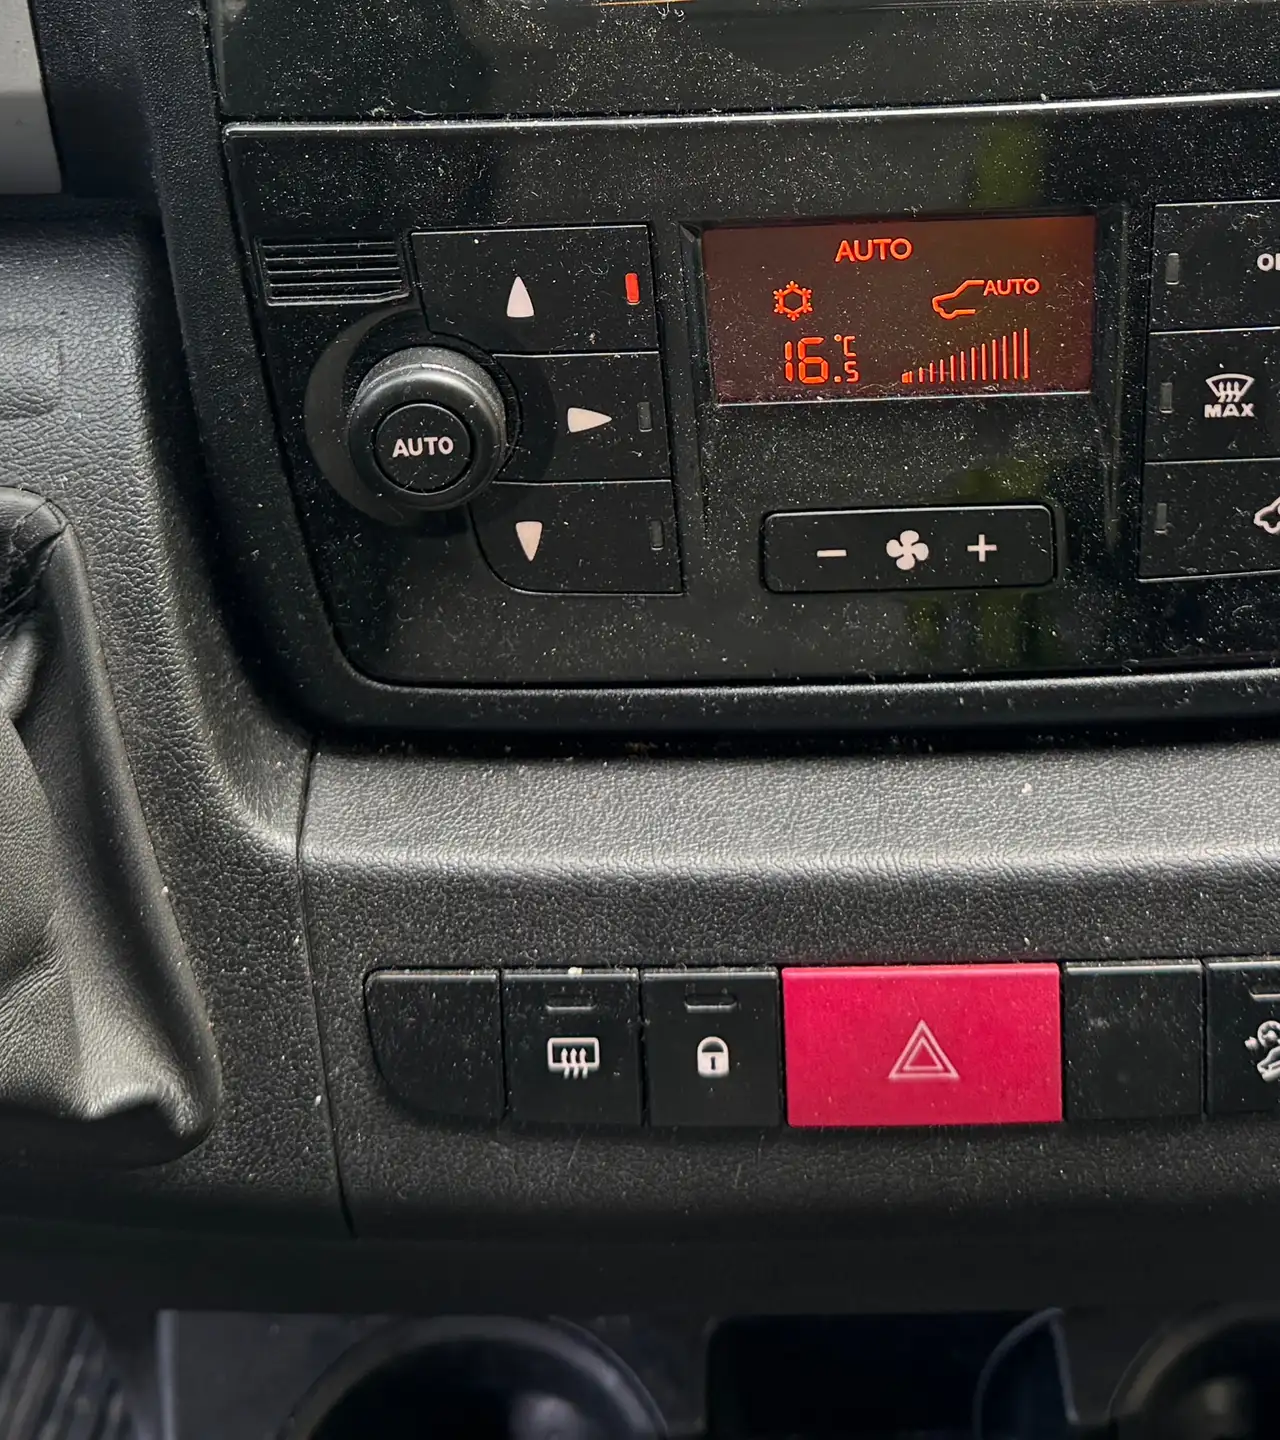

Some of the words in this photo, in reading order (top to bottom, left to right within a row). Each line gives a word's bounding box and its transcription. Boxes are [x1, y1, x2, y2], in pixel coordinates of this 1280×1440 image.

[835, 237, 913, 263] AUTO
[983, 277, 1041, 297] AUTO
[1204, 402, 1256, 419] MAX
[392, 436, 454, 458] AUTO
